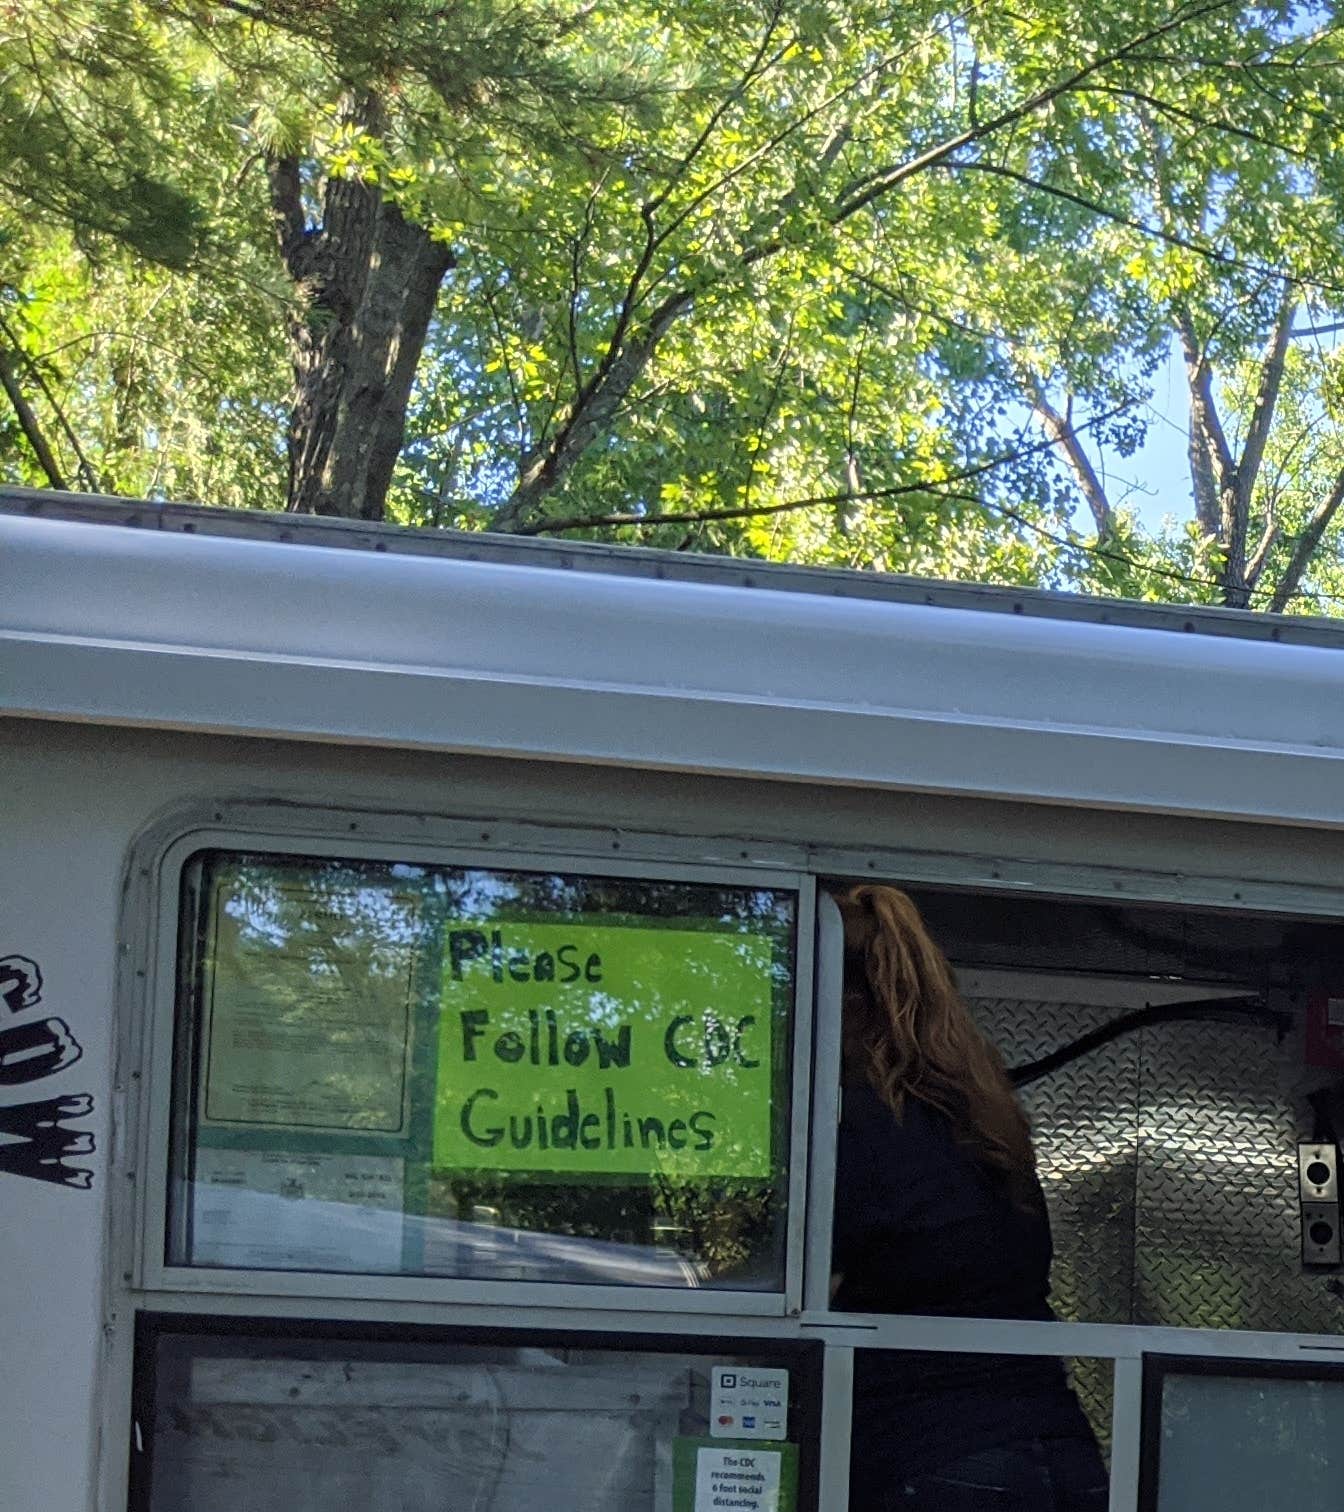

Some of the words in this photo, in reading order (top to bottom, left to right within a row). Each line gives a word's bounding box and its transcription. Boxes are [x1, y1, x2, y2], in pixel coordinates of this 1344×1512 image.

[448, 929, 603, 984] Please
[459, 1008, 632, 1070] Follow
[664, 1014, 761, 1070] CDC
[459, 1086, 717, 1152] Guidelines
[740, 1376, 782, 1389] Square
